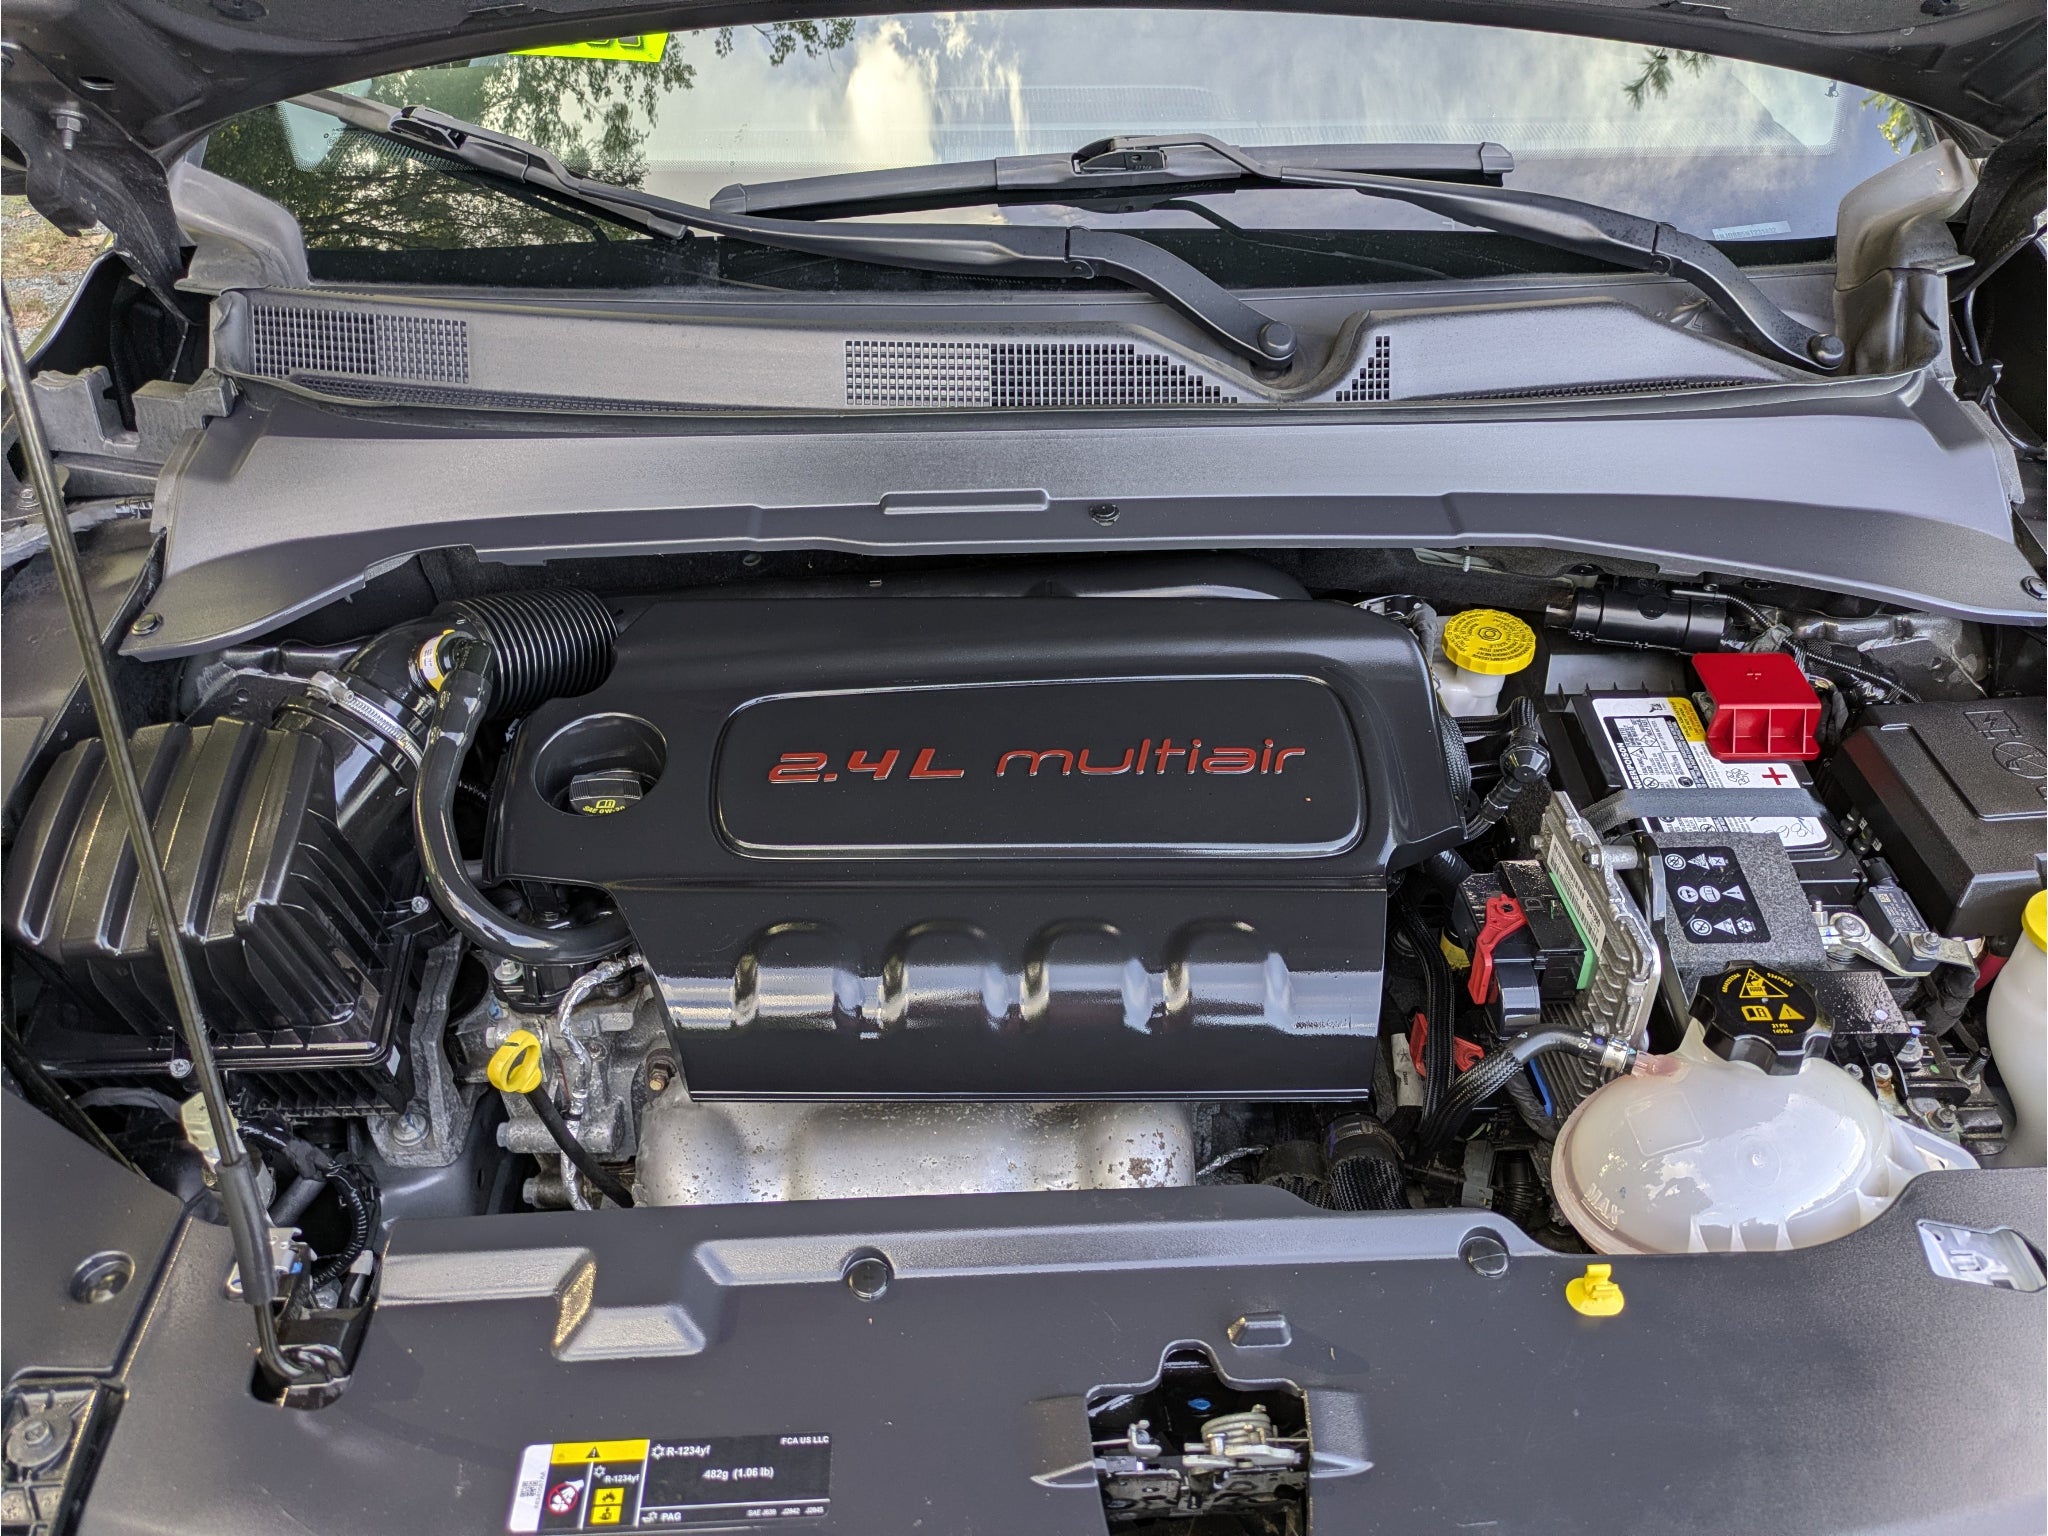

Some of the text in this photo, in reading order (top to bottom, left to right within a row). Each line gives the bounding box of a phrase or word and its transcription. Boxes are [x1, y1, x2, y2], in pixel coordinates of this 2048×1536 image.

[996, 738, 1305, 777] multiair
[1615, 741, 1644, 789] NGER/POISON
[1584, 1182, 1625, 1225] MAX
[780, 1436, 830, 1445] FCA US LLC
[665, 1445, 712, 1457] R-1234yf
[603, 1473, 640, 1485] R-1234yf
[702, 1469, 729, 1481] 482g
[660, 1512, 682, 1522] PAG
